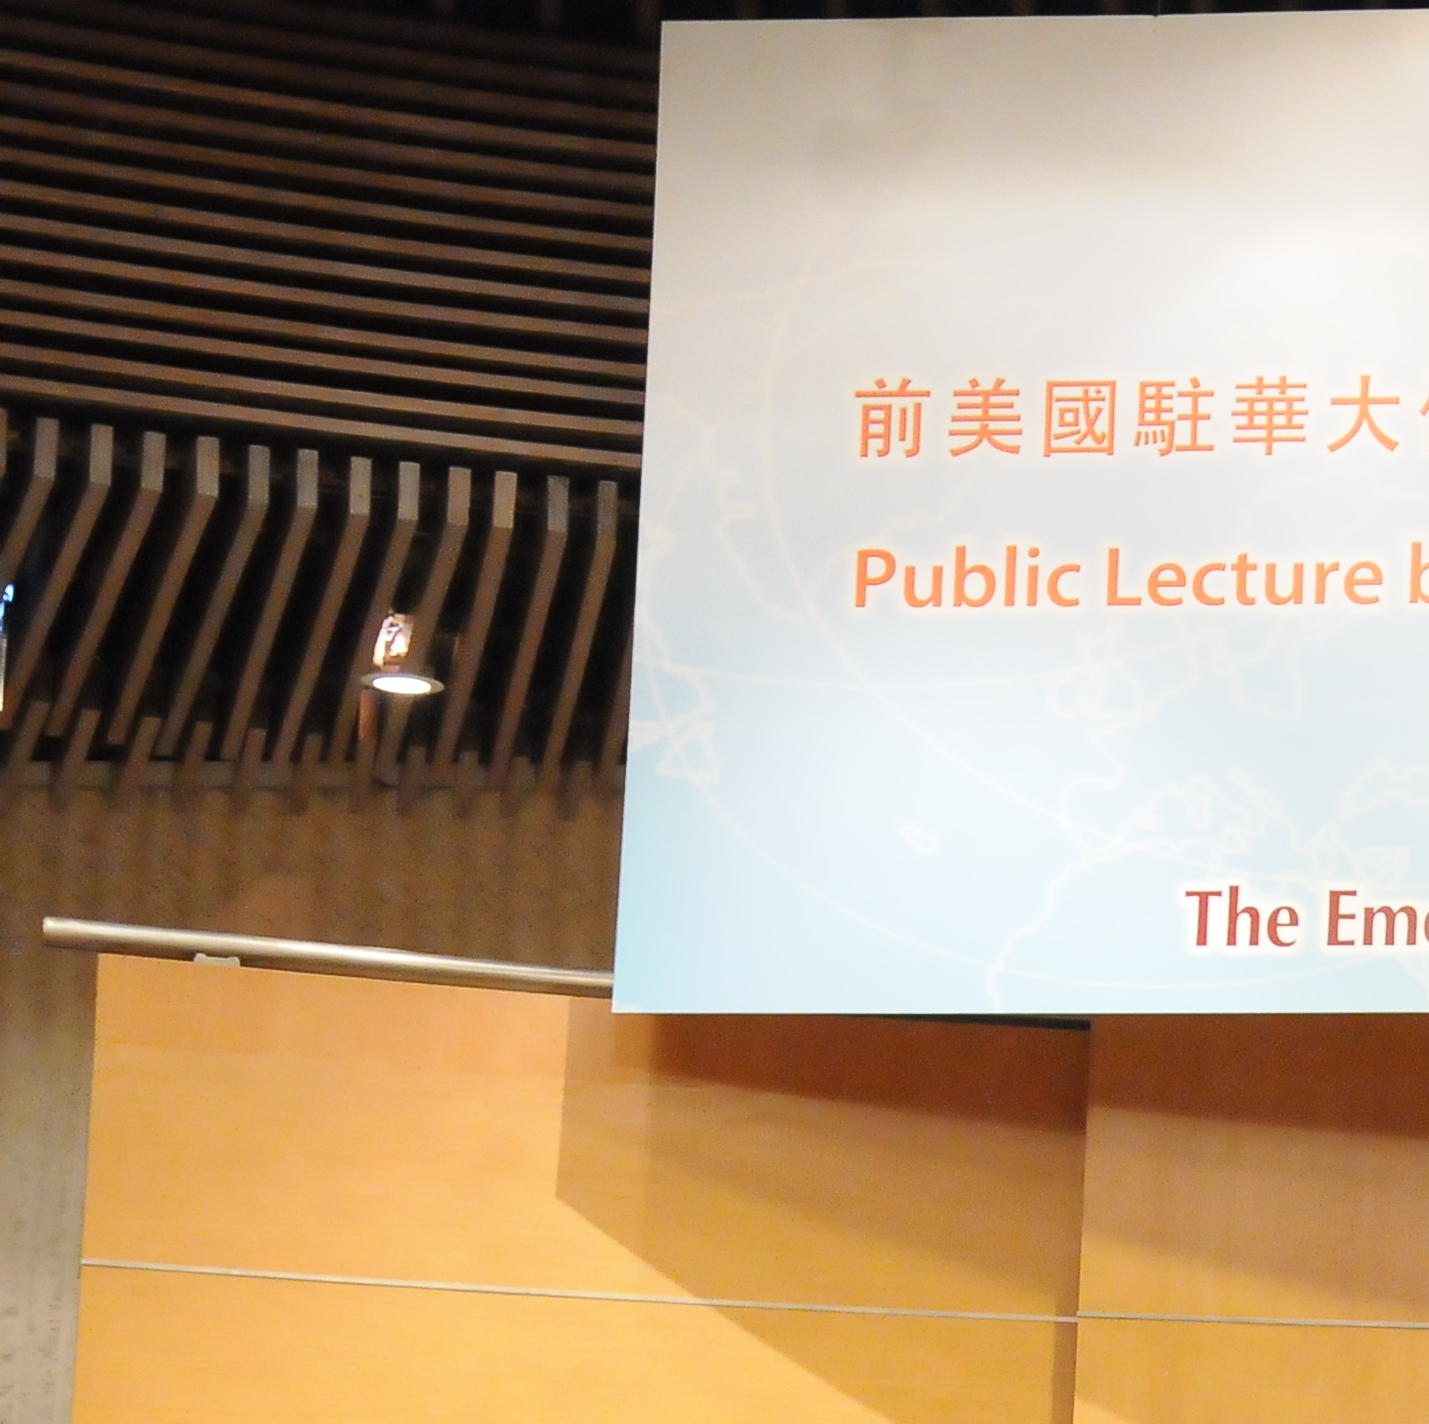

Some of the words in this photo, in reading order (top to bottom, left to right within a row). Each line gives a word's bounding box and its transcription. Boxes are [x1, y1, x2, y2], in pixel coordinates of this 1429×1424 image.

[855, 544, 1081, 608] Public
[1106, 546, 1383, 607] Lecture
[1185, 885, 1299, 948] The
